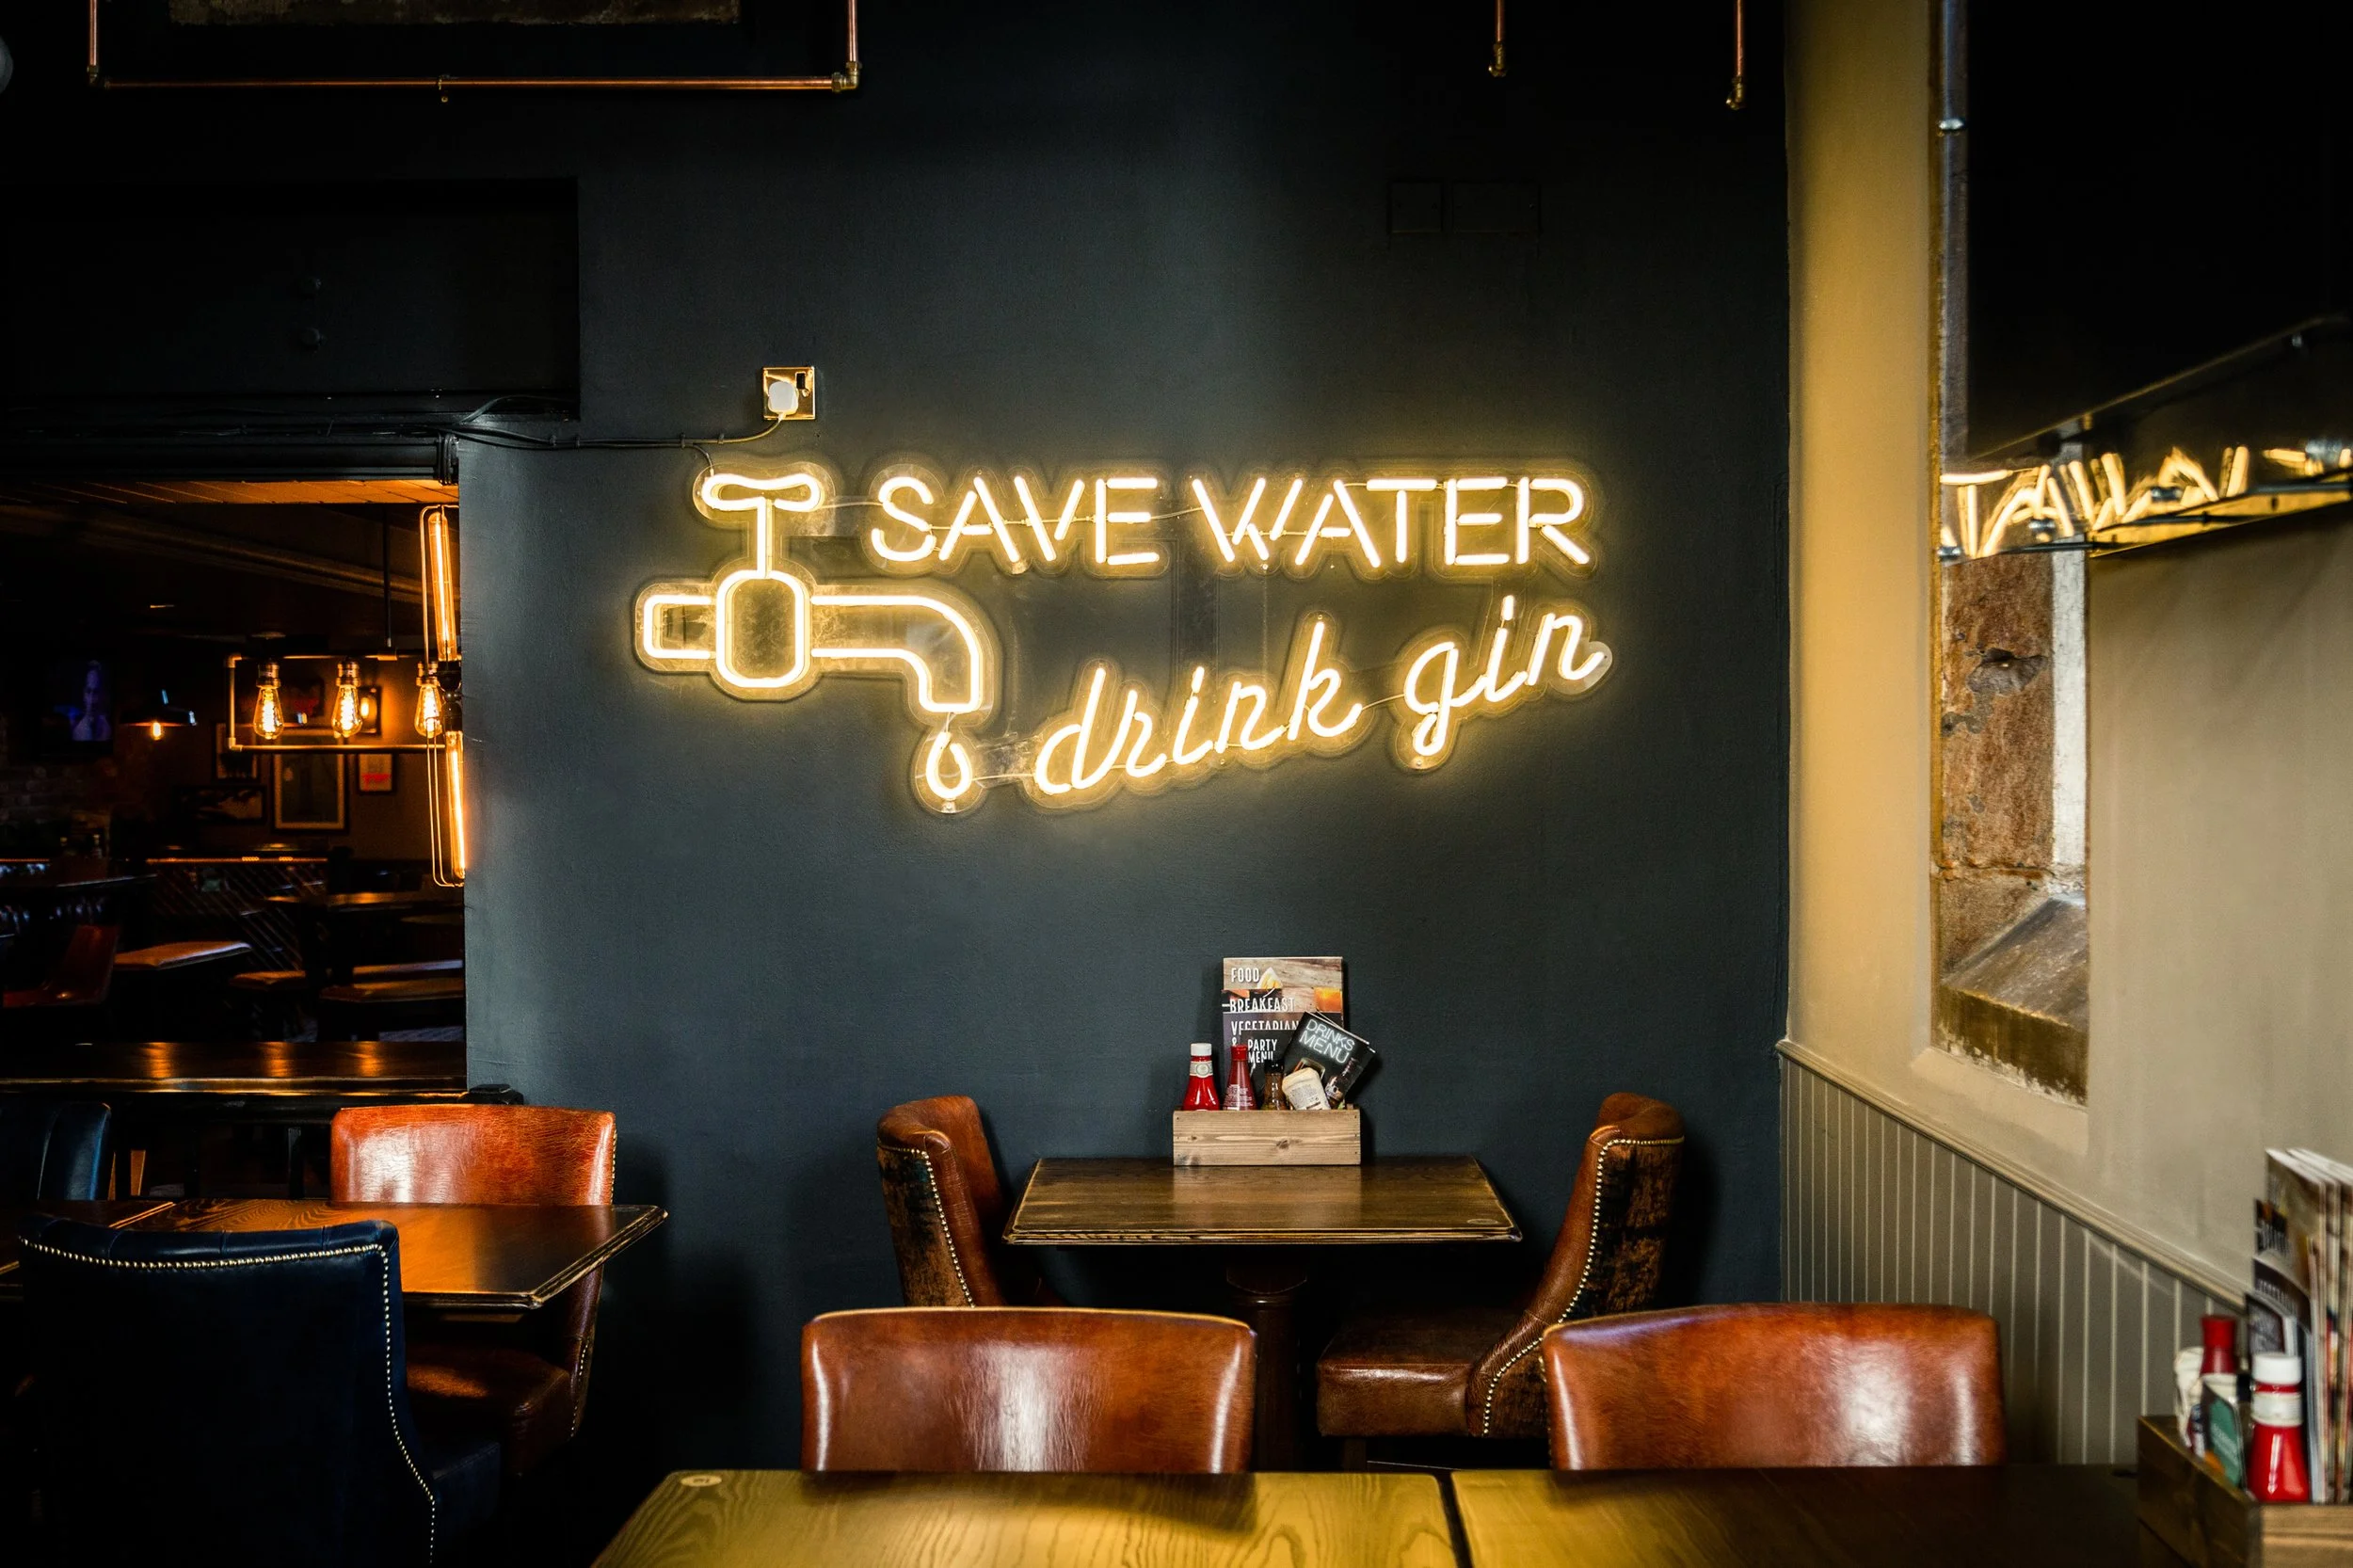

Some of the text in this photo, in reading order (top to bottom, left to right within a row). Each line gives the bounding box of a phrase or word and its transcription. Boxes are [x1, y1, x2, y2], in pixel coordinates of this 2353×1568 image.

[871, 475, 1591, 568] SAVE WATER
[1035, 595, 1606, 794] drink gin
[1231, 967, 1259, 983] FOOD
[1229, 997, 1294, 1013] BREAKFAST
[1247, 1038, 1277, 1051] PARTY
[1305, 1018, 1354, 1051] DRINKS
[1248, 1050, 1273, 1064] MENU
[1299, 1030, 1350, 1064] MENU
